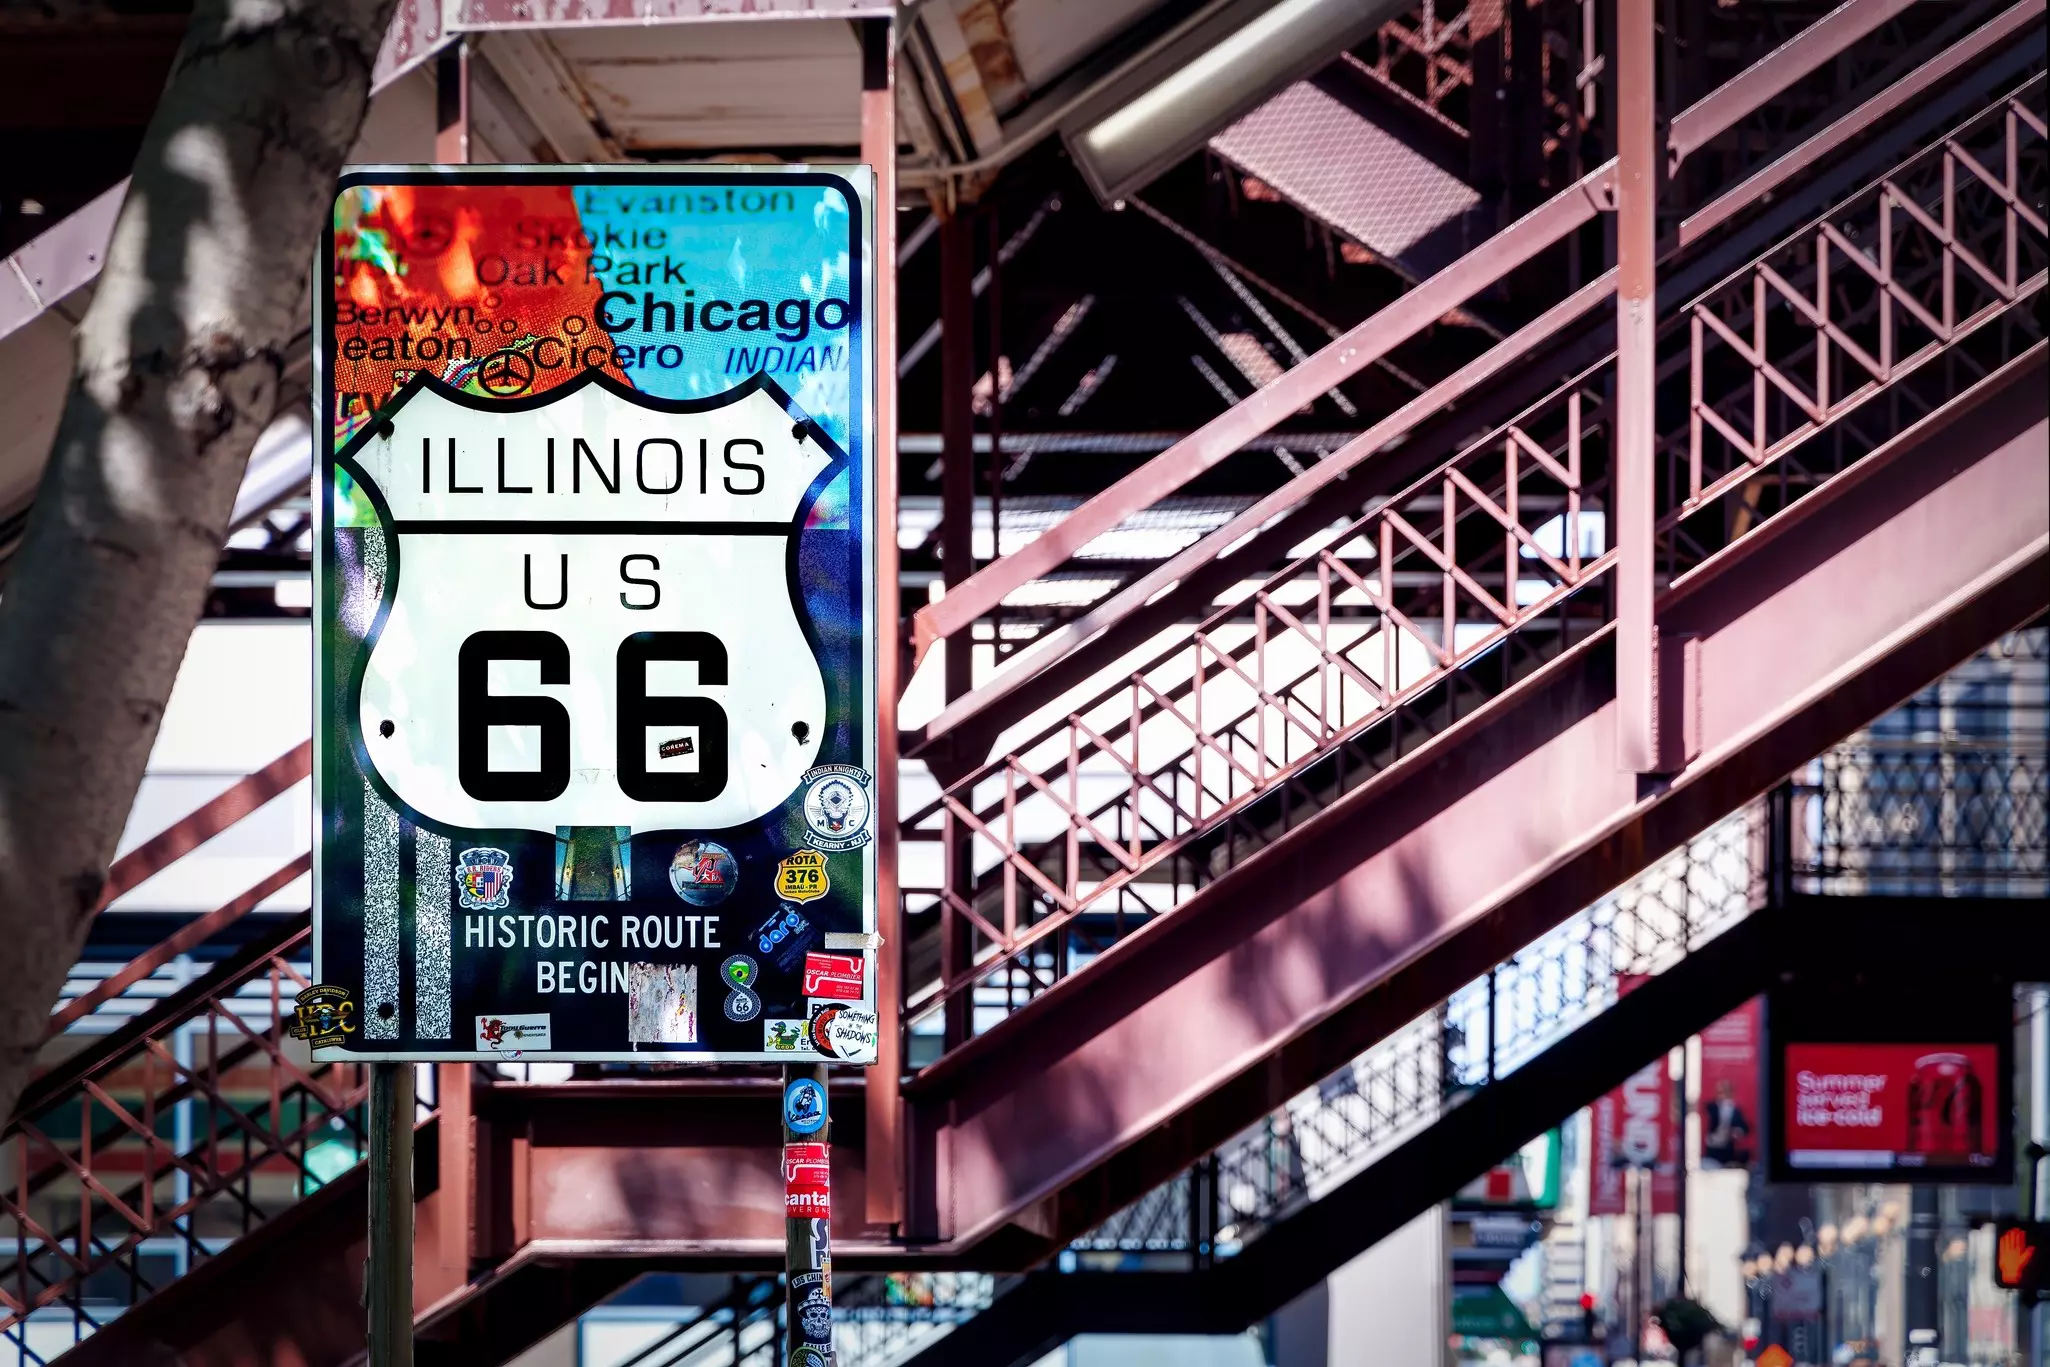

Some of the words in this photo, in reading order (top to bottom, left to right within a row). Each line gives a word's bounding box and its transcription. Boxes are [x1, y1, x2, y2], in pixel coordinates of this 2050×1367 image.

[584, 189, 796, 217] Evanston
[515, 218, 667, 250] Skokie
[477, 256, 563, 286] Oak
[585, 255, 687, 285] Park
[335, 300, 475, 332] Berwyn
[596, 289, 849, 342] Chicago
[335, 331, 473, 361] eaton
[533, 336, 683, 369] Cicero
[725, 345, 849, 374] INDIAN
[421, 436, 766, 495] ILLINOIS
[458, 630, 729, 802] 66
[811, 766, 832, 777] INDIAN
[833, 765, 862, 777] KNIGHTS
[817, 819, 825, 827] M
[848, 819, 855, 827] C
[813, 839, 845, 849] KEARNY
[851, 838, 862, 847] NJ
[786, 855, 818, 865] ROTA
[785, 869, 819, 883] 376
[465, 915, 609, 948] HISTORIC
[621, 915, 721, 948] ROUTE
[537, 961, 630, 994] BEGIN
[806, 968, 829, 977] OSCAR
[319, 988, 346, 996] DAVIDSON
[736, 1002, 750, 1012] 66
[838, 1010, 875, 1024] SOMETHING
[835, 1027, 872, 1043] SHADOWS
[1796, 1070, 1888, 1093] Summer
[785, 1190, 830, 1206] cantal
[793, 1276, 806, 1286] LOS
[806, 1273, 823, 1281] CHIN
